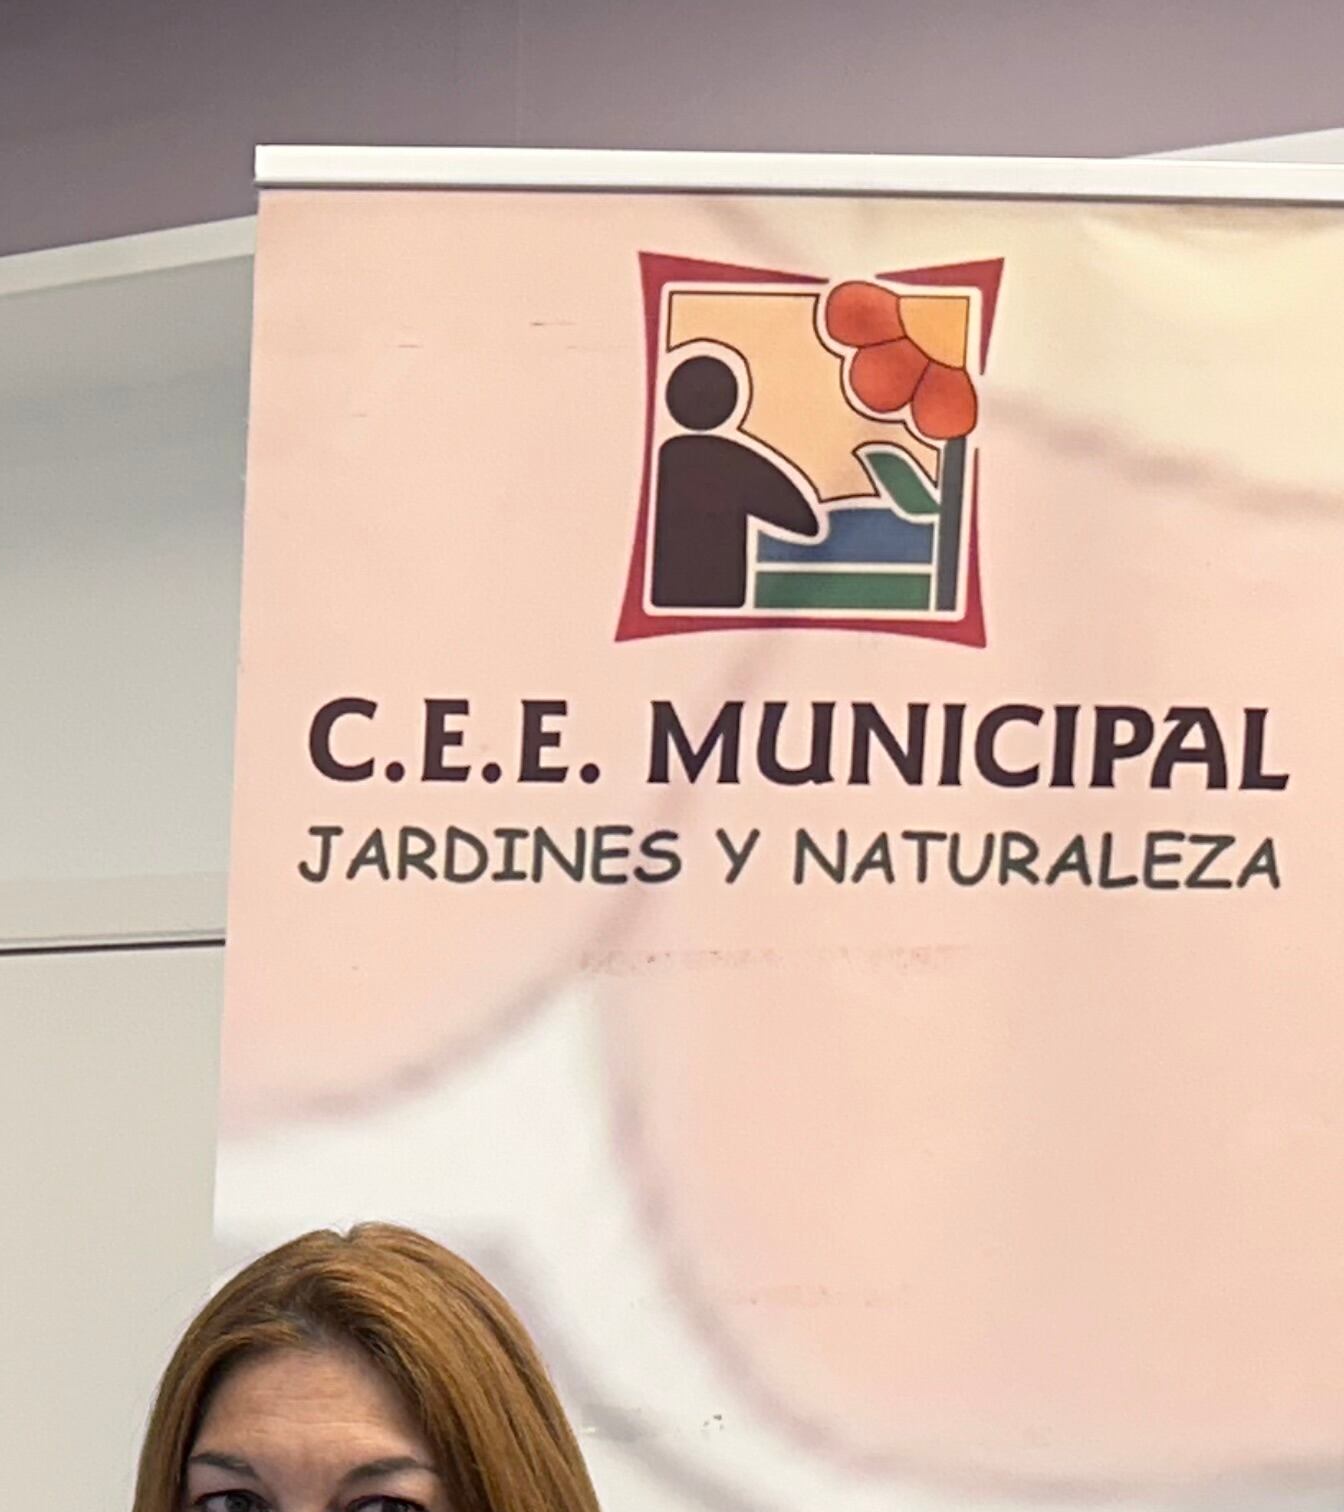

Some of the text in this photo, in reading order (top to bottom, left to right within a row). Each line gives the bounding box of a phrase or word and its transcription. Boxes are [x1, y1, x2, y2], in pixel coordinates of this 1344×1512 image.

[308, 698, 1290, 792] C.E.E. MUNICIPAL
[298, 824, 1282, 891] JARDINES Y NATURALEZA
